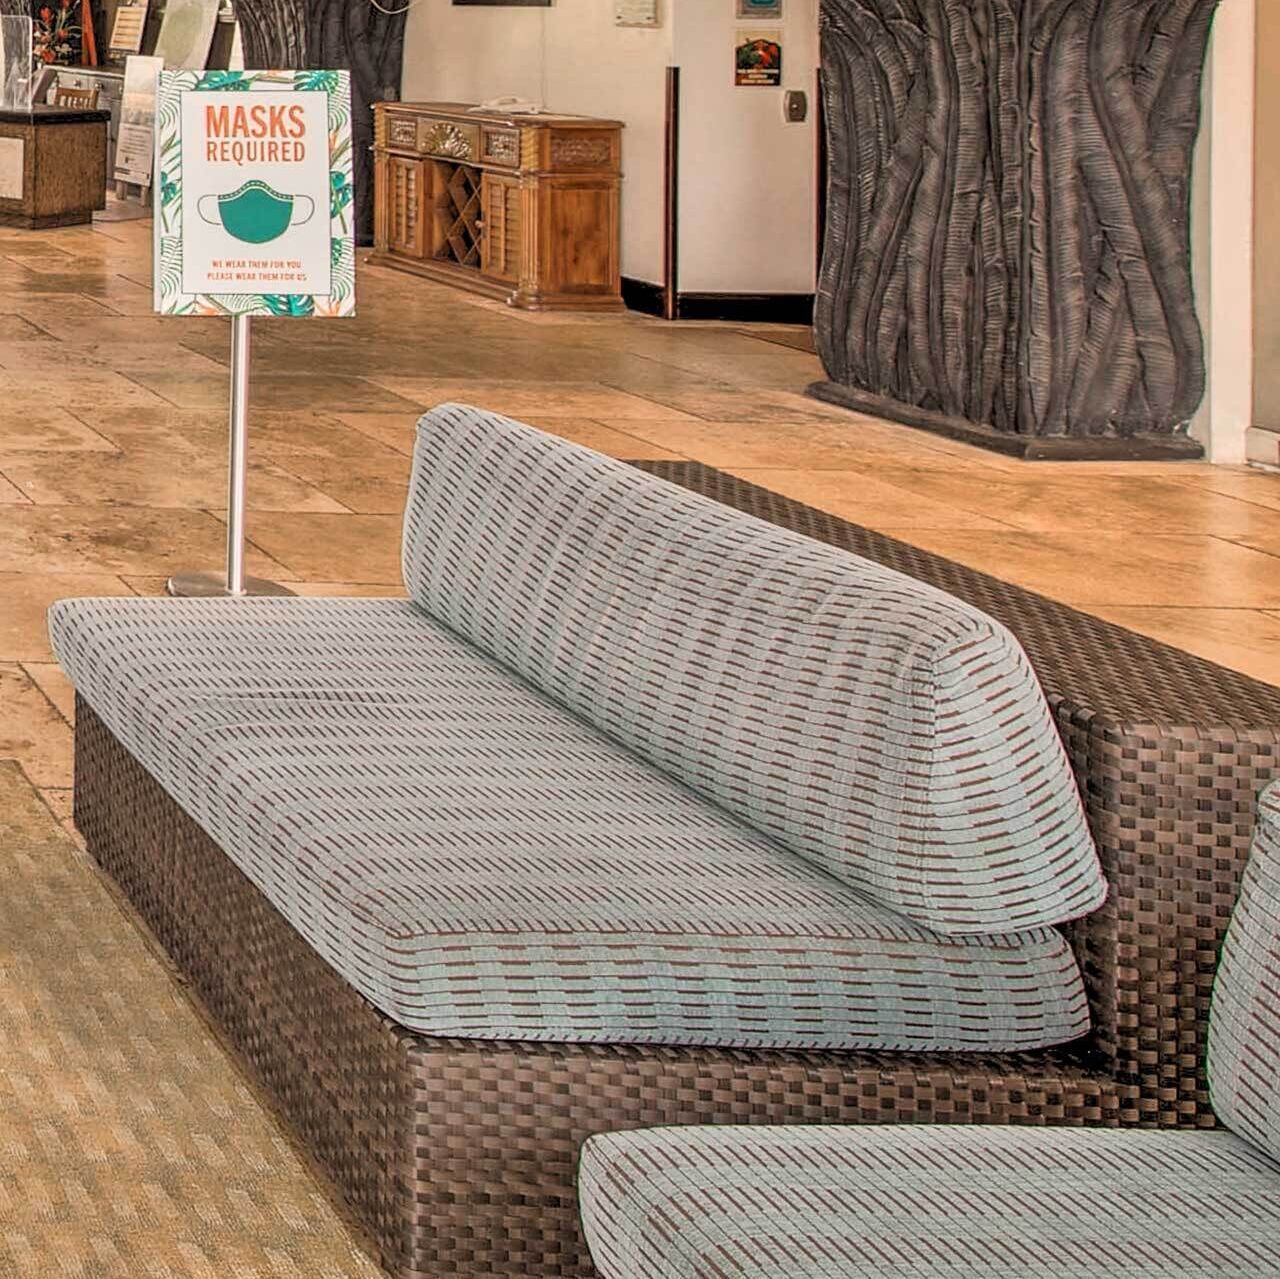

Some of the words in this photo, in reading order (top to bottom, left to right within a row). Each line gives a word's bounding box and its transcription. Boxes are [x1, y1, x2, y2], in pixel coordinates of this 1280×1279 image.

[206, 105, 305, 138] MASKS
[206, 141, 305, 166] REQUIRED
[225, 260, 246, 268] WEAR
[248, 260, 268, 268] THEM
